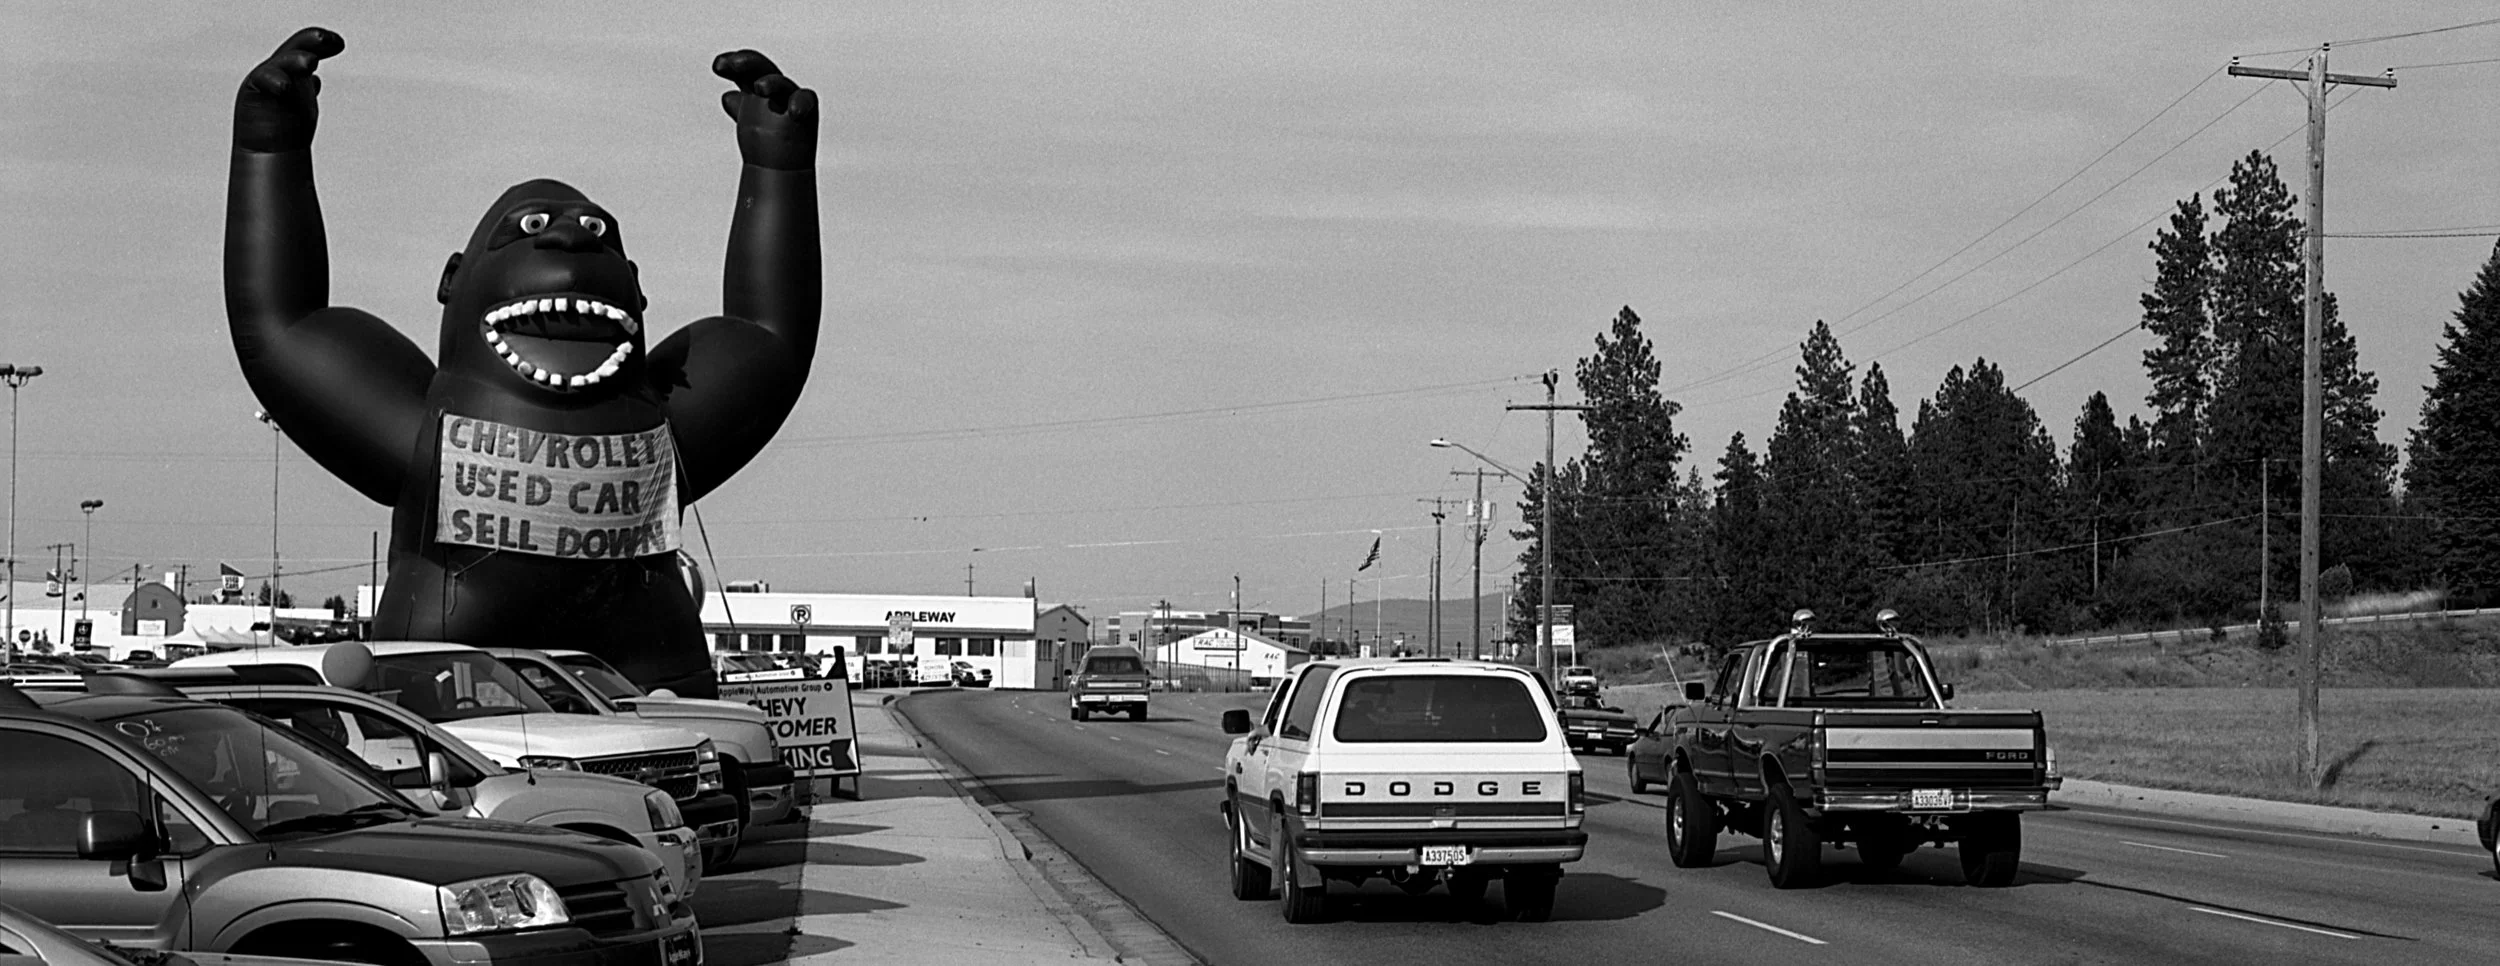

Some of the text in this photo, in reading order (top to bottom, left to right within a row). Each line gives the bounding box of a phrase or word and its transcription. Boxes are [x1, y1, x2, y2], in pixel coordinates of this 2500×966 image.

[449, 418, 655, 469] CHEVROLET
[455, 461, 641, 515] USED CAR
[452, 509, 666, 558] SELL DOWN
[757, 685, 799, 695] Automotive
[801, 683, 822, 692] Group
[1985, 751, 2029, 760] FORD
[1345, 781, 1542, 796] DODGE
